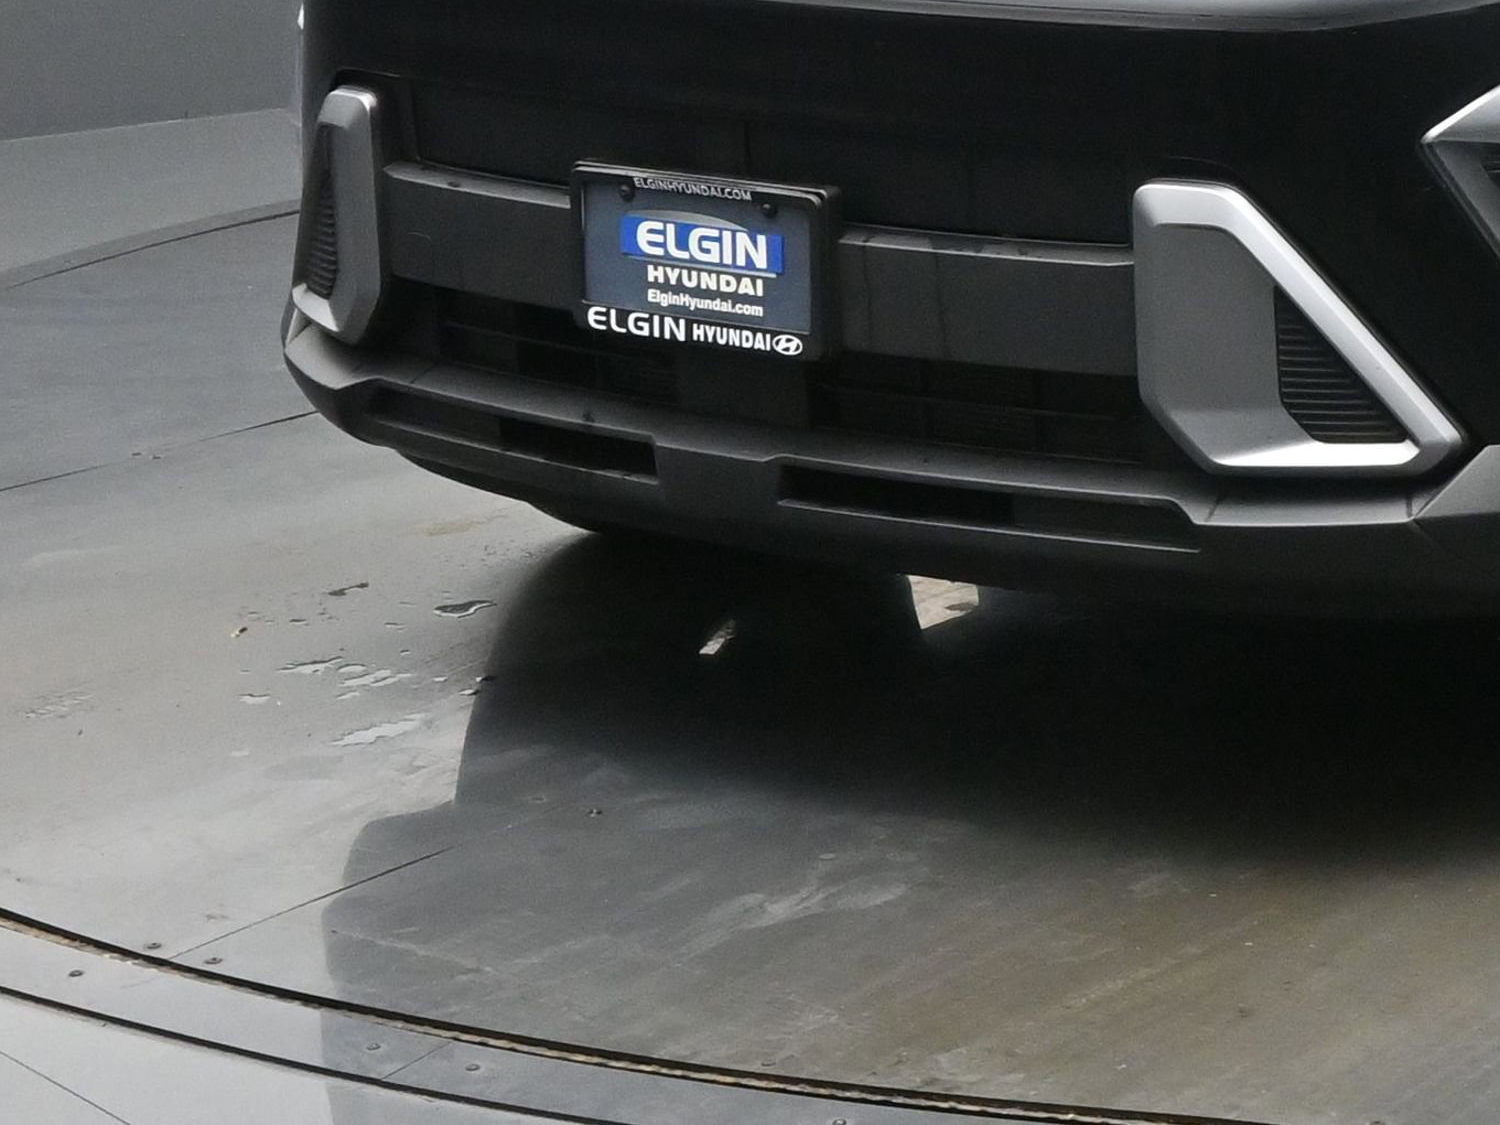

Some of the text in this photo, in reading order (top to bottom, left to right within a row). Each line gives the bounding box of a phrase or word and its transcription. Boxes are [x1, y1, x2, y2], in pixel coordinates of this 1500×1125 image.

[633, 177, 753, 201] ELGINHYUNDAI.COM
[636, 220, 768, 270] ELGIN
[647, 265, 764, 297] HYUNDAI
[647, 289, 764, 317] ElginHyundai.com
[586, 306, 772, 352] ELGIN HYUNDAI
